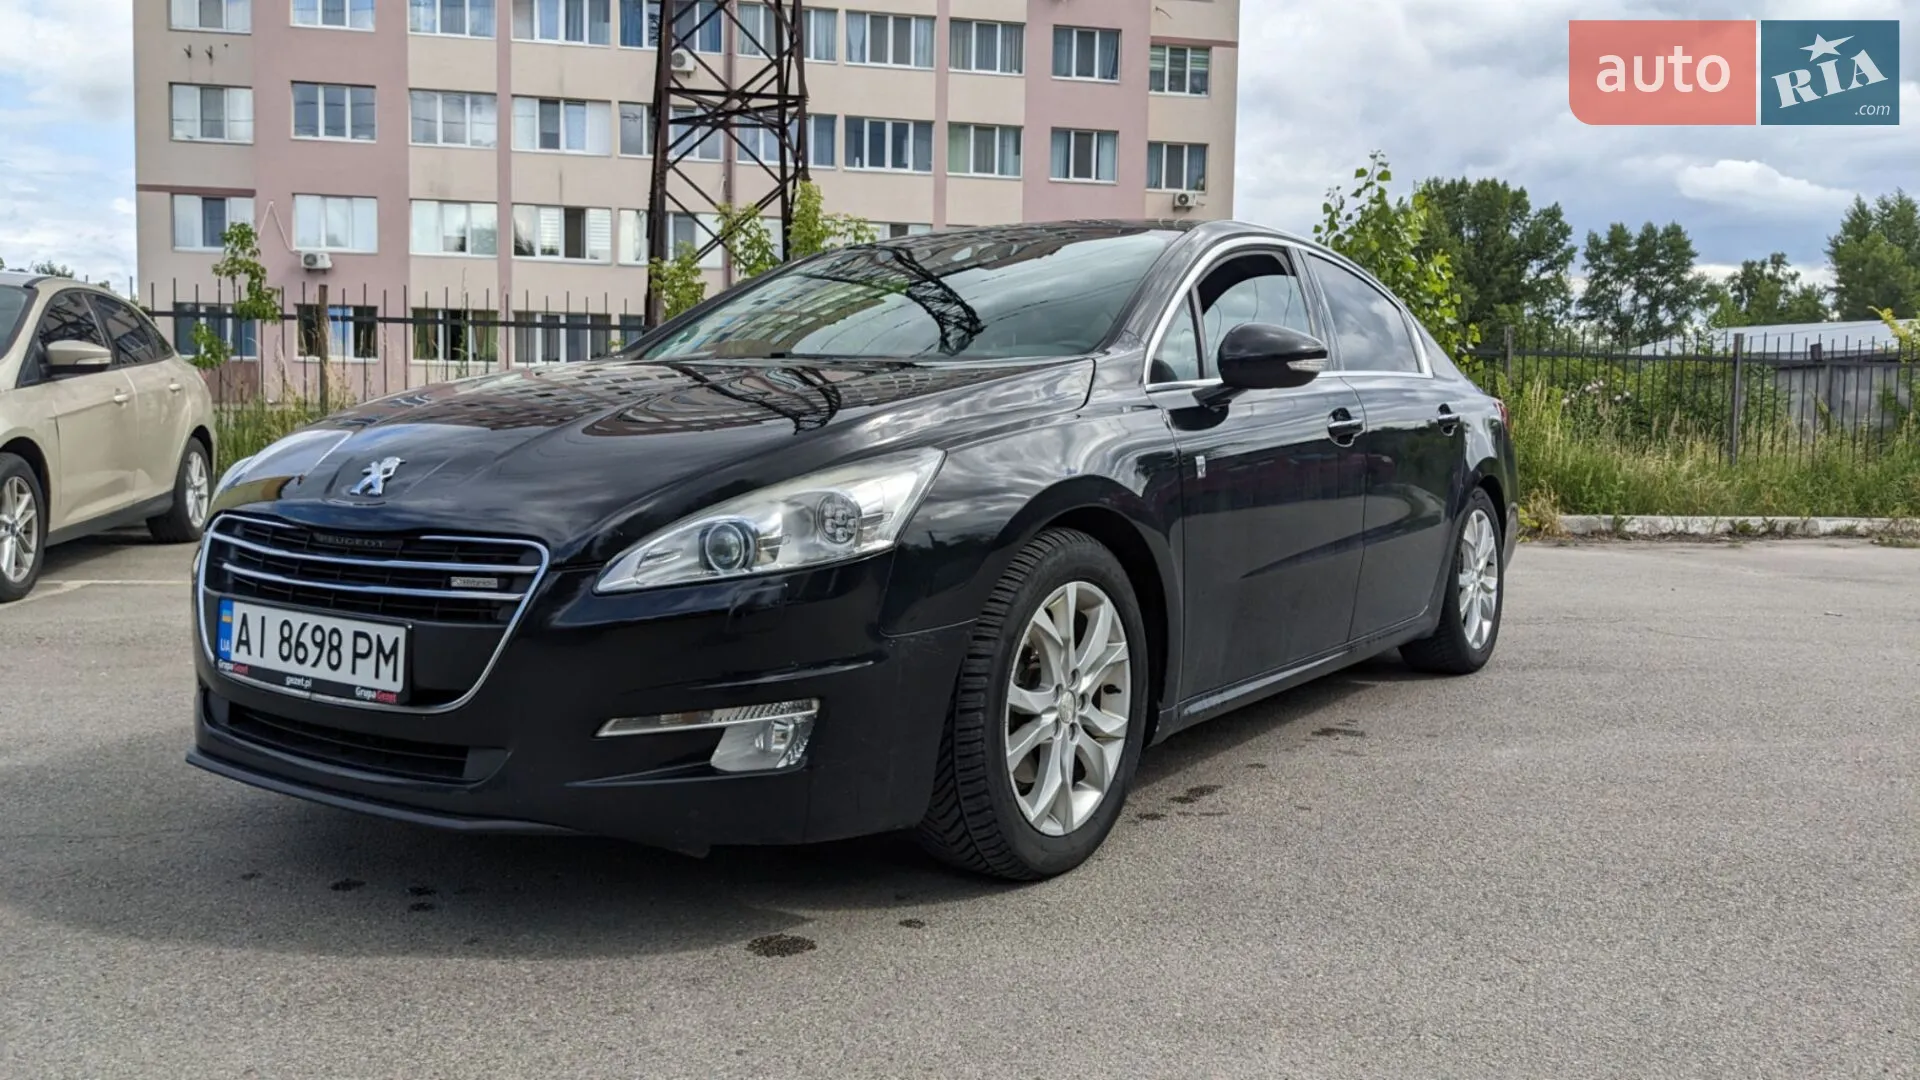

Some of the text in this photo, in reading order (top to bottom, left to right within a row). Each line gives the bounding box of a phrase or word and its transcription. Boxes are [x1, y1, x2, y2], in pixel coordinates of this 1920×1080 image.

[319, 534, 385, 548] PEUGEOT
[220, 638, 231, 651] UA
[235, 612, 399, 682] AI 8698 PM
